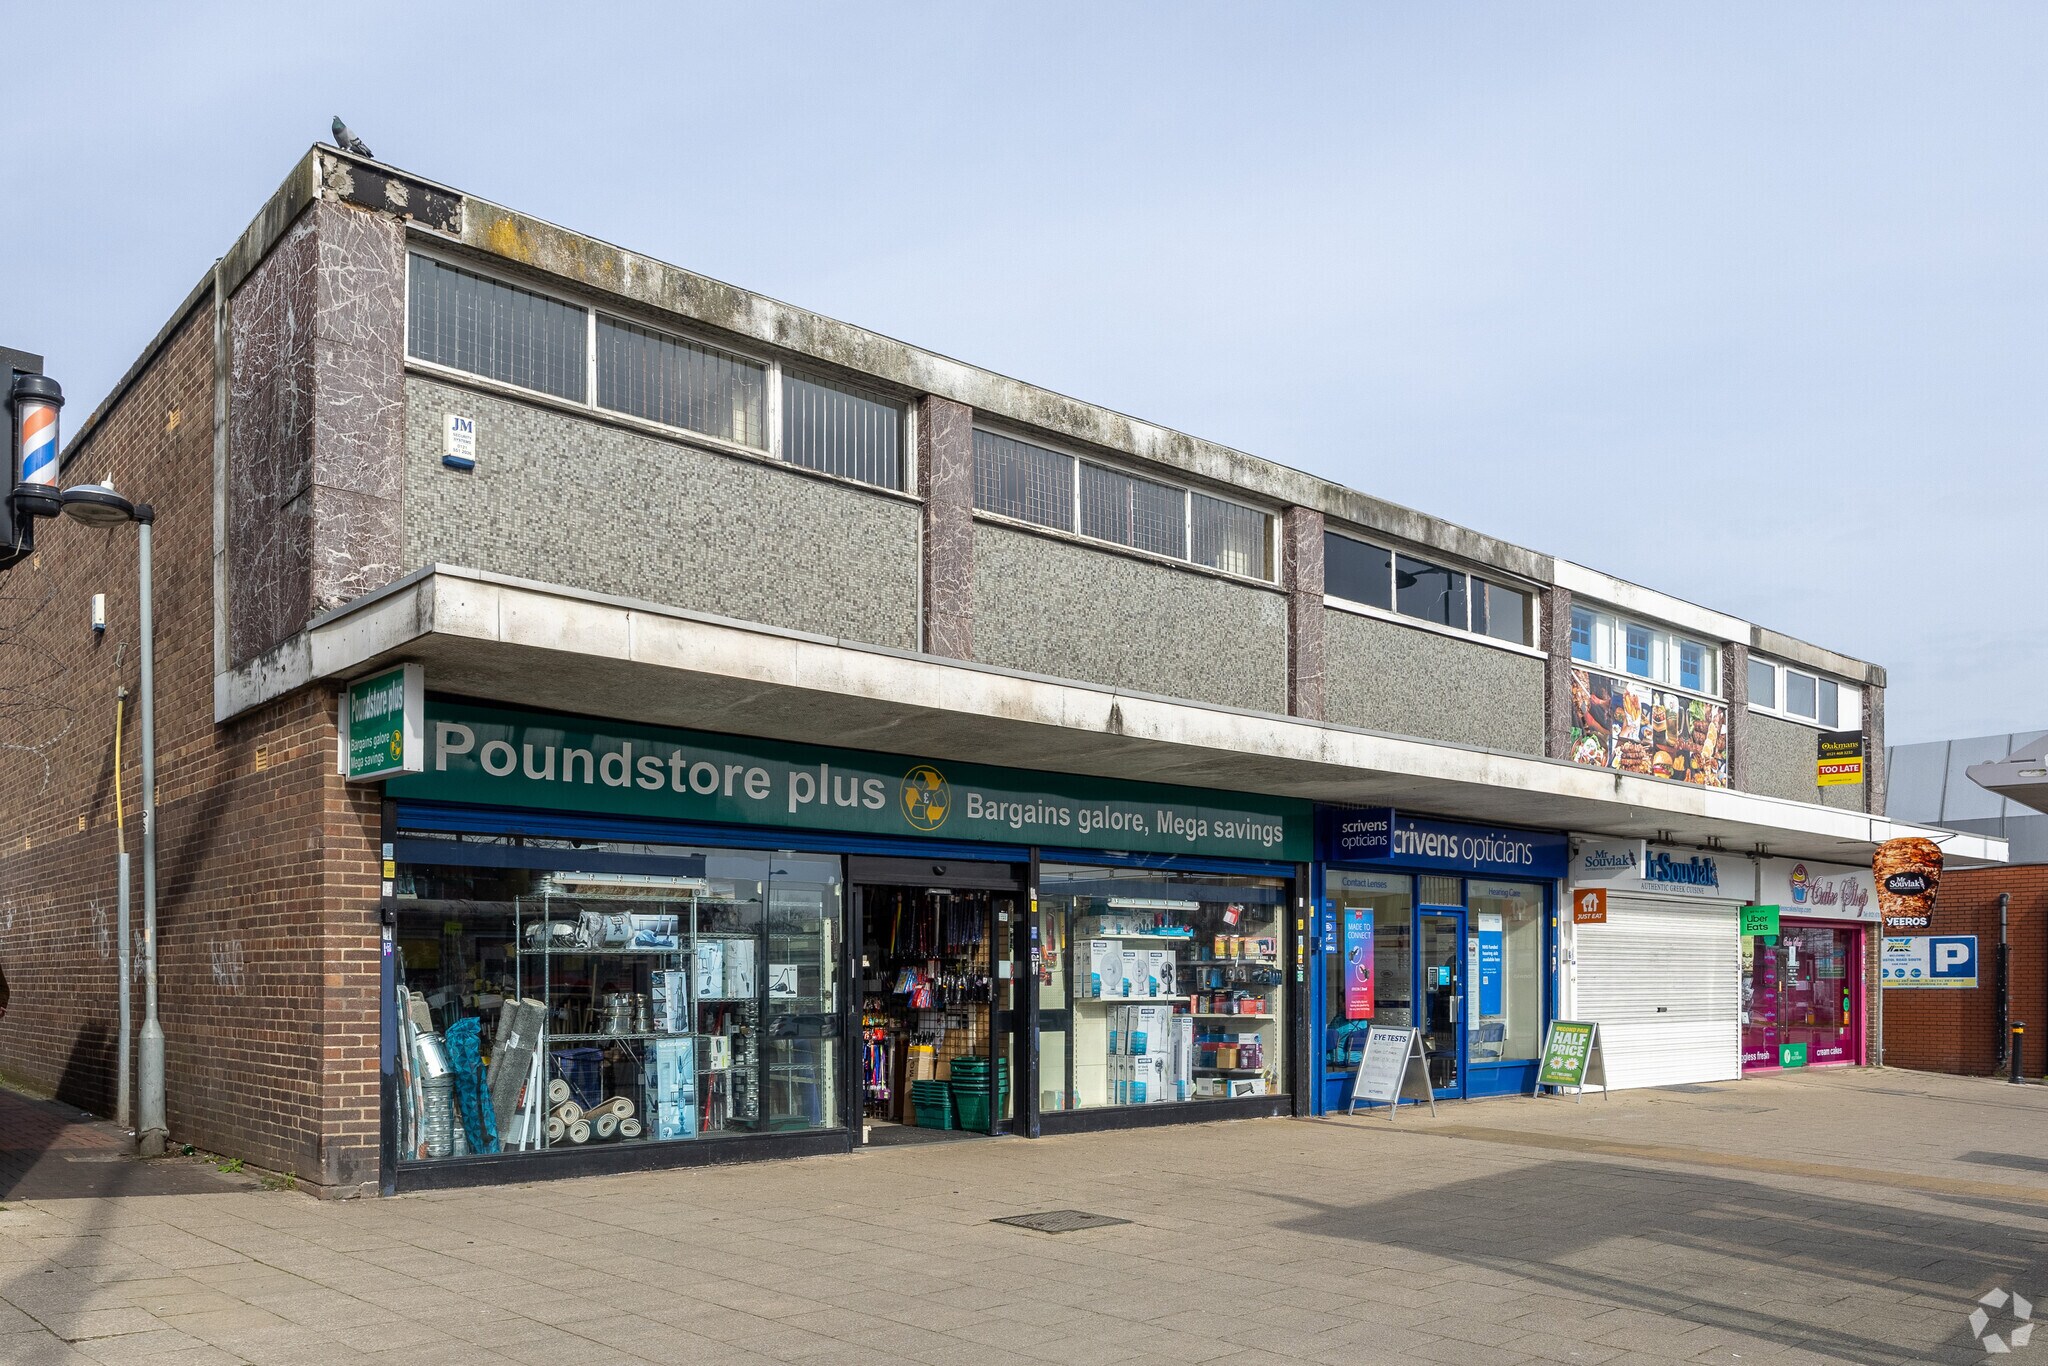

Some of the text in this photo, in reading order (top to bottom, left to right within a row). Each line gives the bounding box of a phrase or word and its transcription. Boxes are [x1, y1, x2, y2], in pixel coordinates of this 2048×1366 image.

[452, 417, 472, 433] JM
[351, 680, 403, 723] Poundstore plus
[351, 732, 390, 752] Bargains galore
[1822, 741, 1859, 750] Oakmans
[351, 751, 384, 771] Mega savings
[435, 721, 886, 813] Poundstore plus
[1820, 764, 1859, 773] TOO LATE
[966, 792, 1284, 847] Bargains galore, Mega savings
[1342, 819, 1388, 834] scrivens
[1341, 833, 1388, 849] opticians
[1394, 822, 1533, 868] crivens opticians
[1595, 849, 1608, 858] Mr
[1342, 876, 1388, 889] Contact Lenses
[1641, 882, 1669, 892] AUTHENTIC
[1669, 885, 1686, 893] GREEK
[1488, 887, 1521, 898] Hearing Care
[1810, 875, 1869, 918] Cake Shop
[1746, 915, 1768, 923] Uber
[1885, 917, 1928, 926] YEEROS
[1348, 923, 1362, 931] MADE
[1746, 923, 1769, 931] Eats
[1347, 931, 1371, 939] CONNECT
[1935, 943, 1969, 972] P
[1373, 1033, 1407, 1042] EYE TESTS
[1553, 1032, 1588, 1046] HALF
[1550, 1043, 1585, 1057] PRICE
[1757, 1050, 1770, 1060] fresh
[1816, 1047, 1842, 1057] cream cakes
